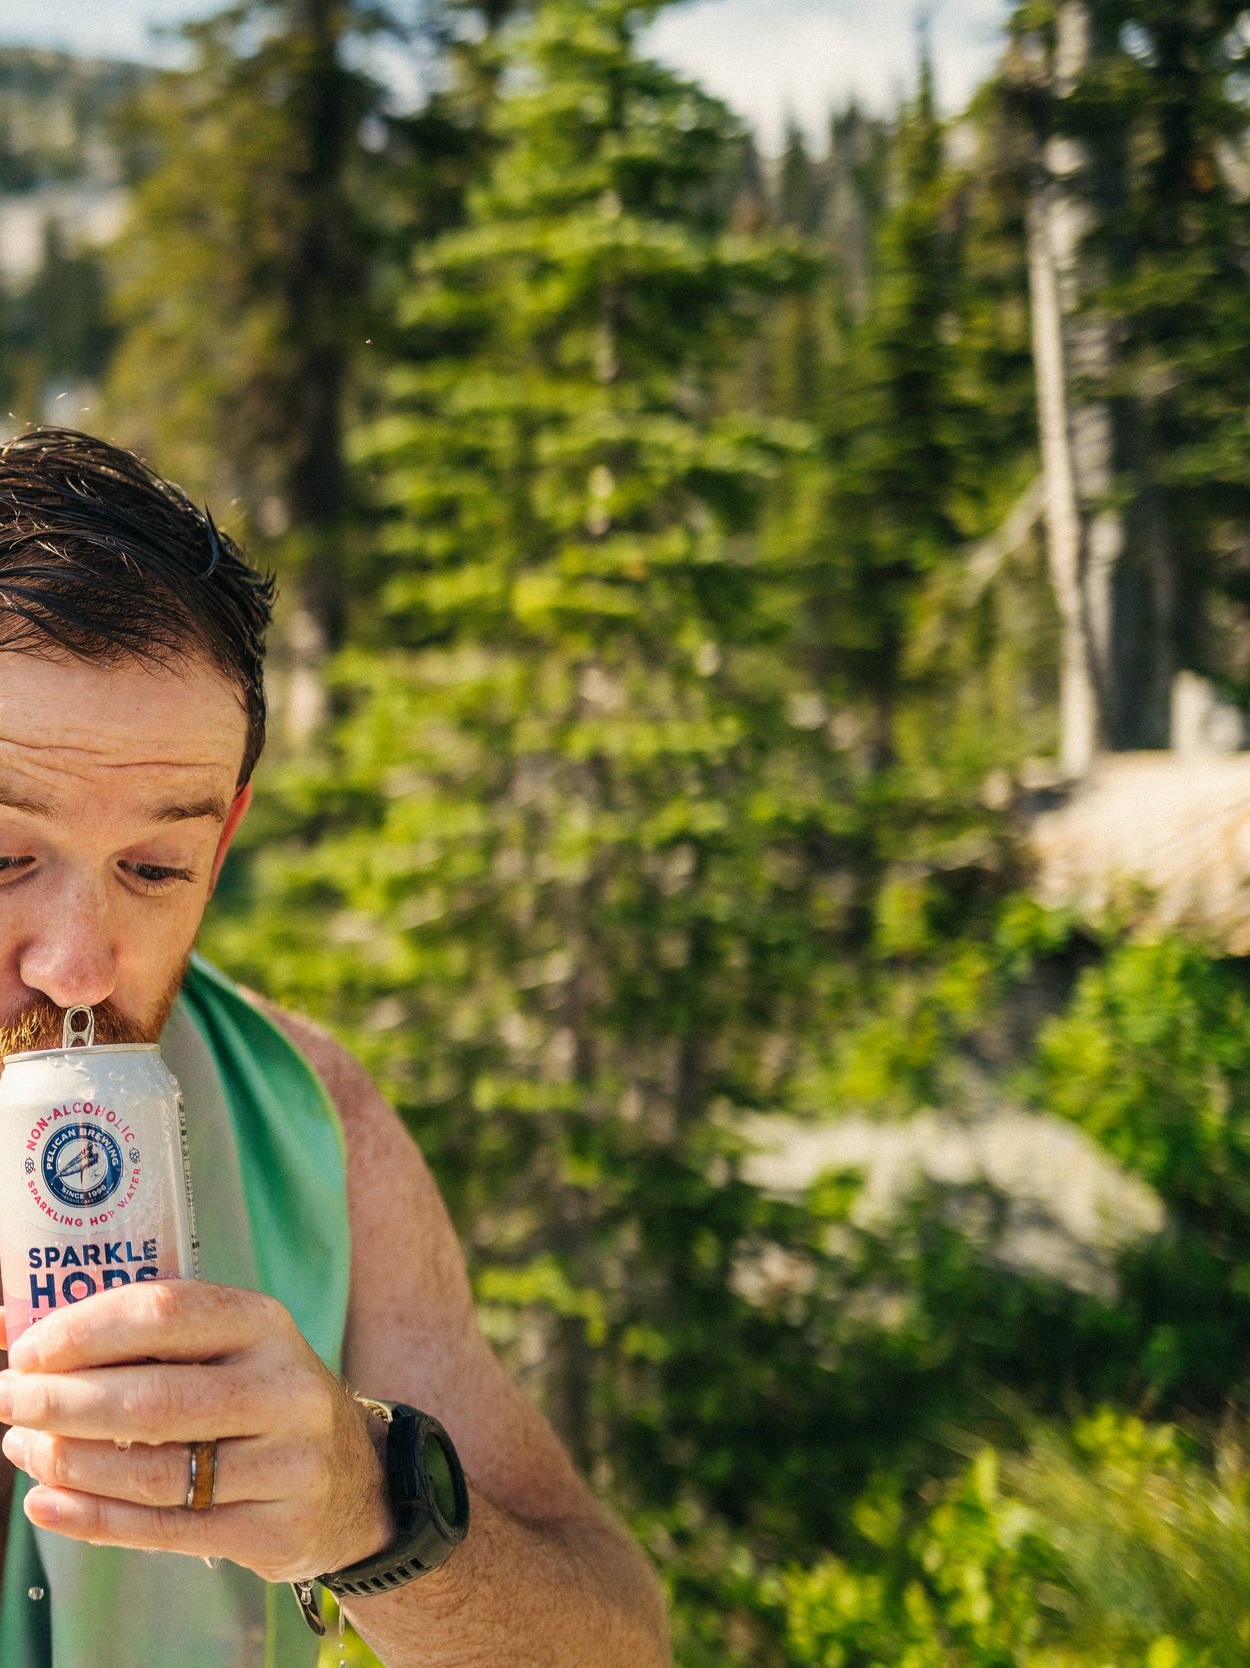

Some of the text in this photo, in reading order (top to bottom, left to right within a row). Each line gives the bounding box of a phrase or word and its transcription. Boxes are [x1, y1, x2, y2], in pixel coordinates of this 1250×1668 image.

[27, 1102, 135, 1151] NON-ALCOHOLIC
[47, 1128, 118, 1170] PELICAN BREWING
[28, 1168, 141, 1226] SPARKLING HOP WATER
[62, 1186, 85, 1199] SINCE
[88, 1185, 107, 1198] 1996
[29, 1238, 157, 1268] SPARKLE
